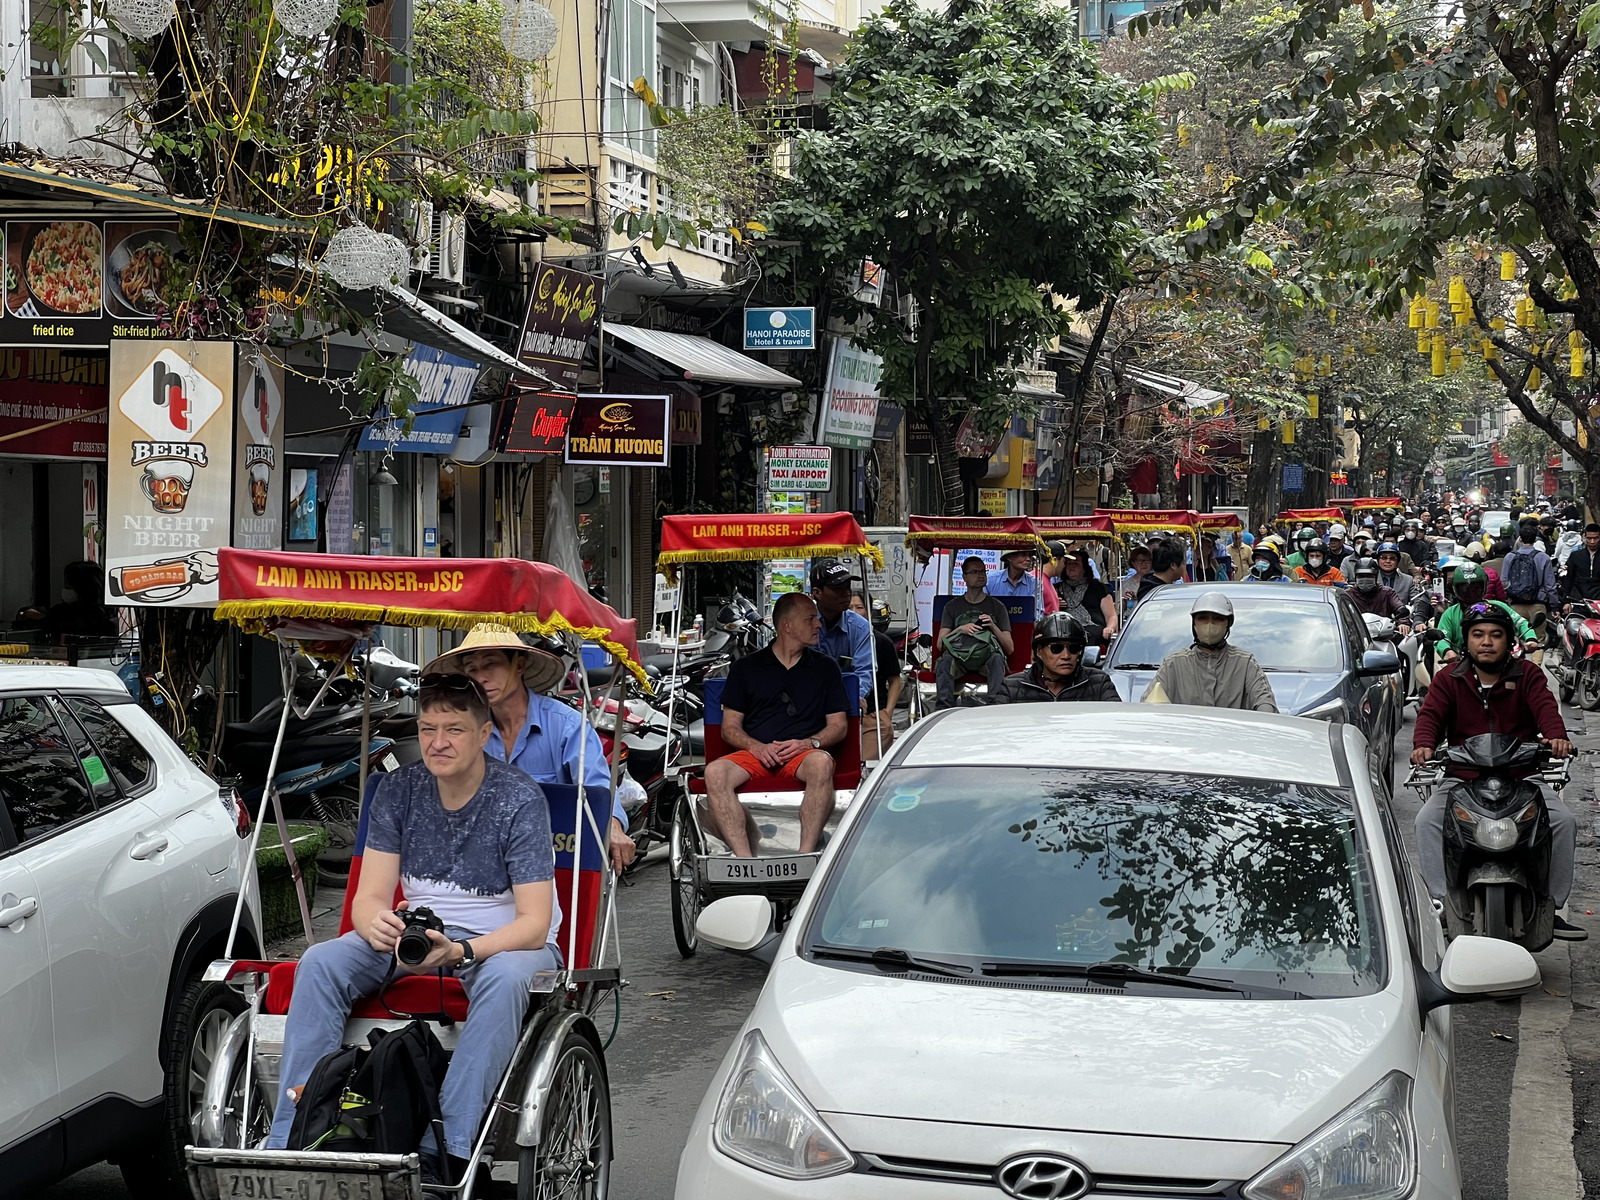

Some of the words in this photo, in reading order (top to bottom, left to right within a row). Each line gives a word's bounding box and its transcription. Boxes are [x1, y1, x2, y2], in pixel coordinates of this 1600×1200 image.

[32, 324, 55, 336] fried
[56, 325, 75, 336] rice
[112, 325, 150, 337] Stir-fried
[747, 330, 771, 338] HANOI
[772, 330, 811, 338] PARADISE
[831, 388, 859, 414] BOOKING
[858, 394, 877, 417] OFFICE
[570, 431, 611, 453] TRẦM
[614, 438, 663, 455] HƯƠNG
[133, 442, 207, 466] BEER
[246, 445, 275, 468] BEER
[771, 448, 787, 458] TOUR
[788, 448, 829, 459] INFORMATION
[771, 459, 794, 467] MONEY
[795, 460, 829, 468] EXCHANGE
[772, 470, 789, 478] TAXI
[791, 470, 827, 479] AIRPORT
[770, 480, 780, 488] SIM
[781, 480, 794, 488] CARD
[84, 479, 96, 511] 70
[123, 515, 214, 532] NIGHT
[240, 517, 276, 533] NIGHT
[692, 525, 718, 538] LAM
[720, 525, 744, 537] ANH
[133, 532, 202, 548] BEER
[244, 534, 272, 549] BEER
[129, 577, 141, 587] 70
[256, 566, 298, 588] LAM
[303, 569, 343, 590] ANH
[551, 833, 575, 853] SC
[726, 863, 798, 878] 29XL-0089
